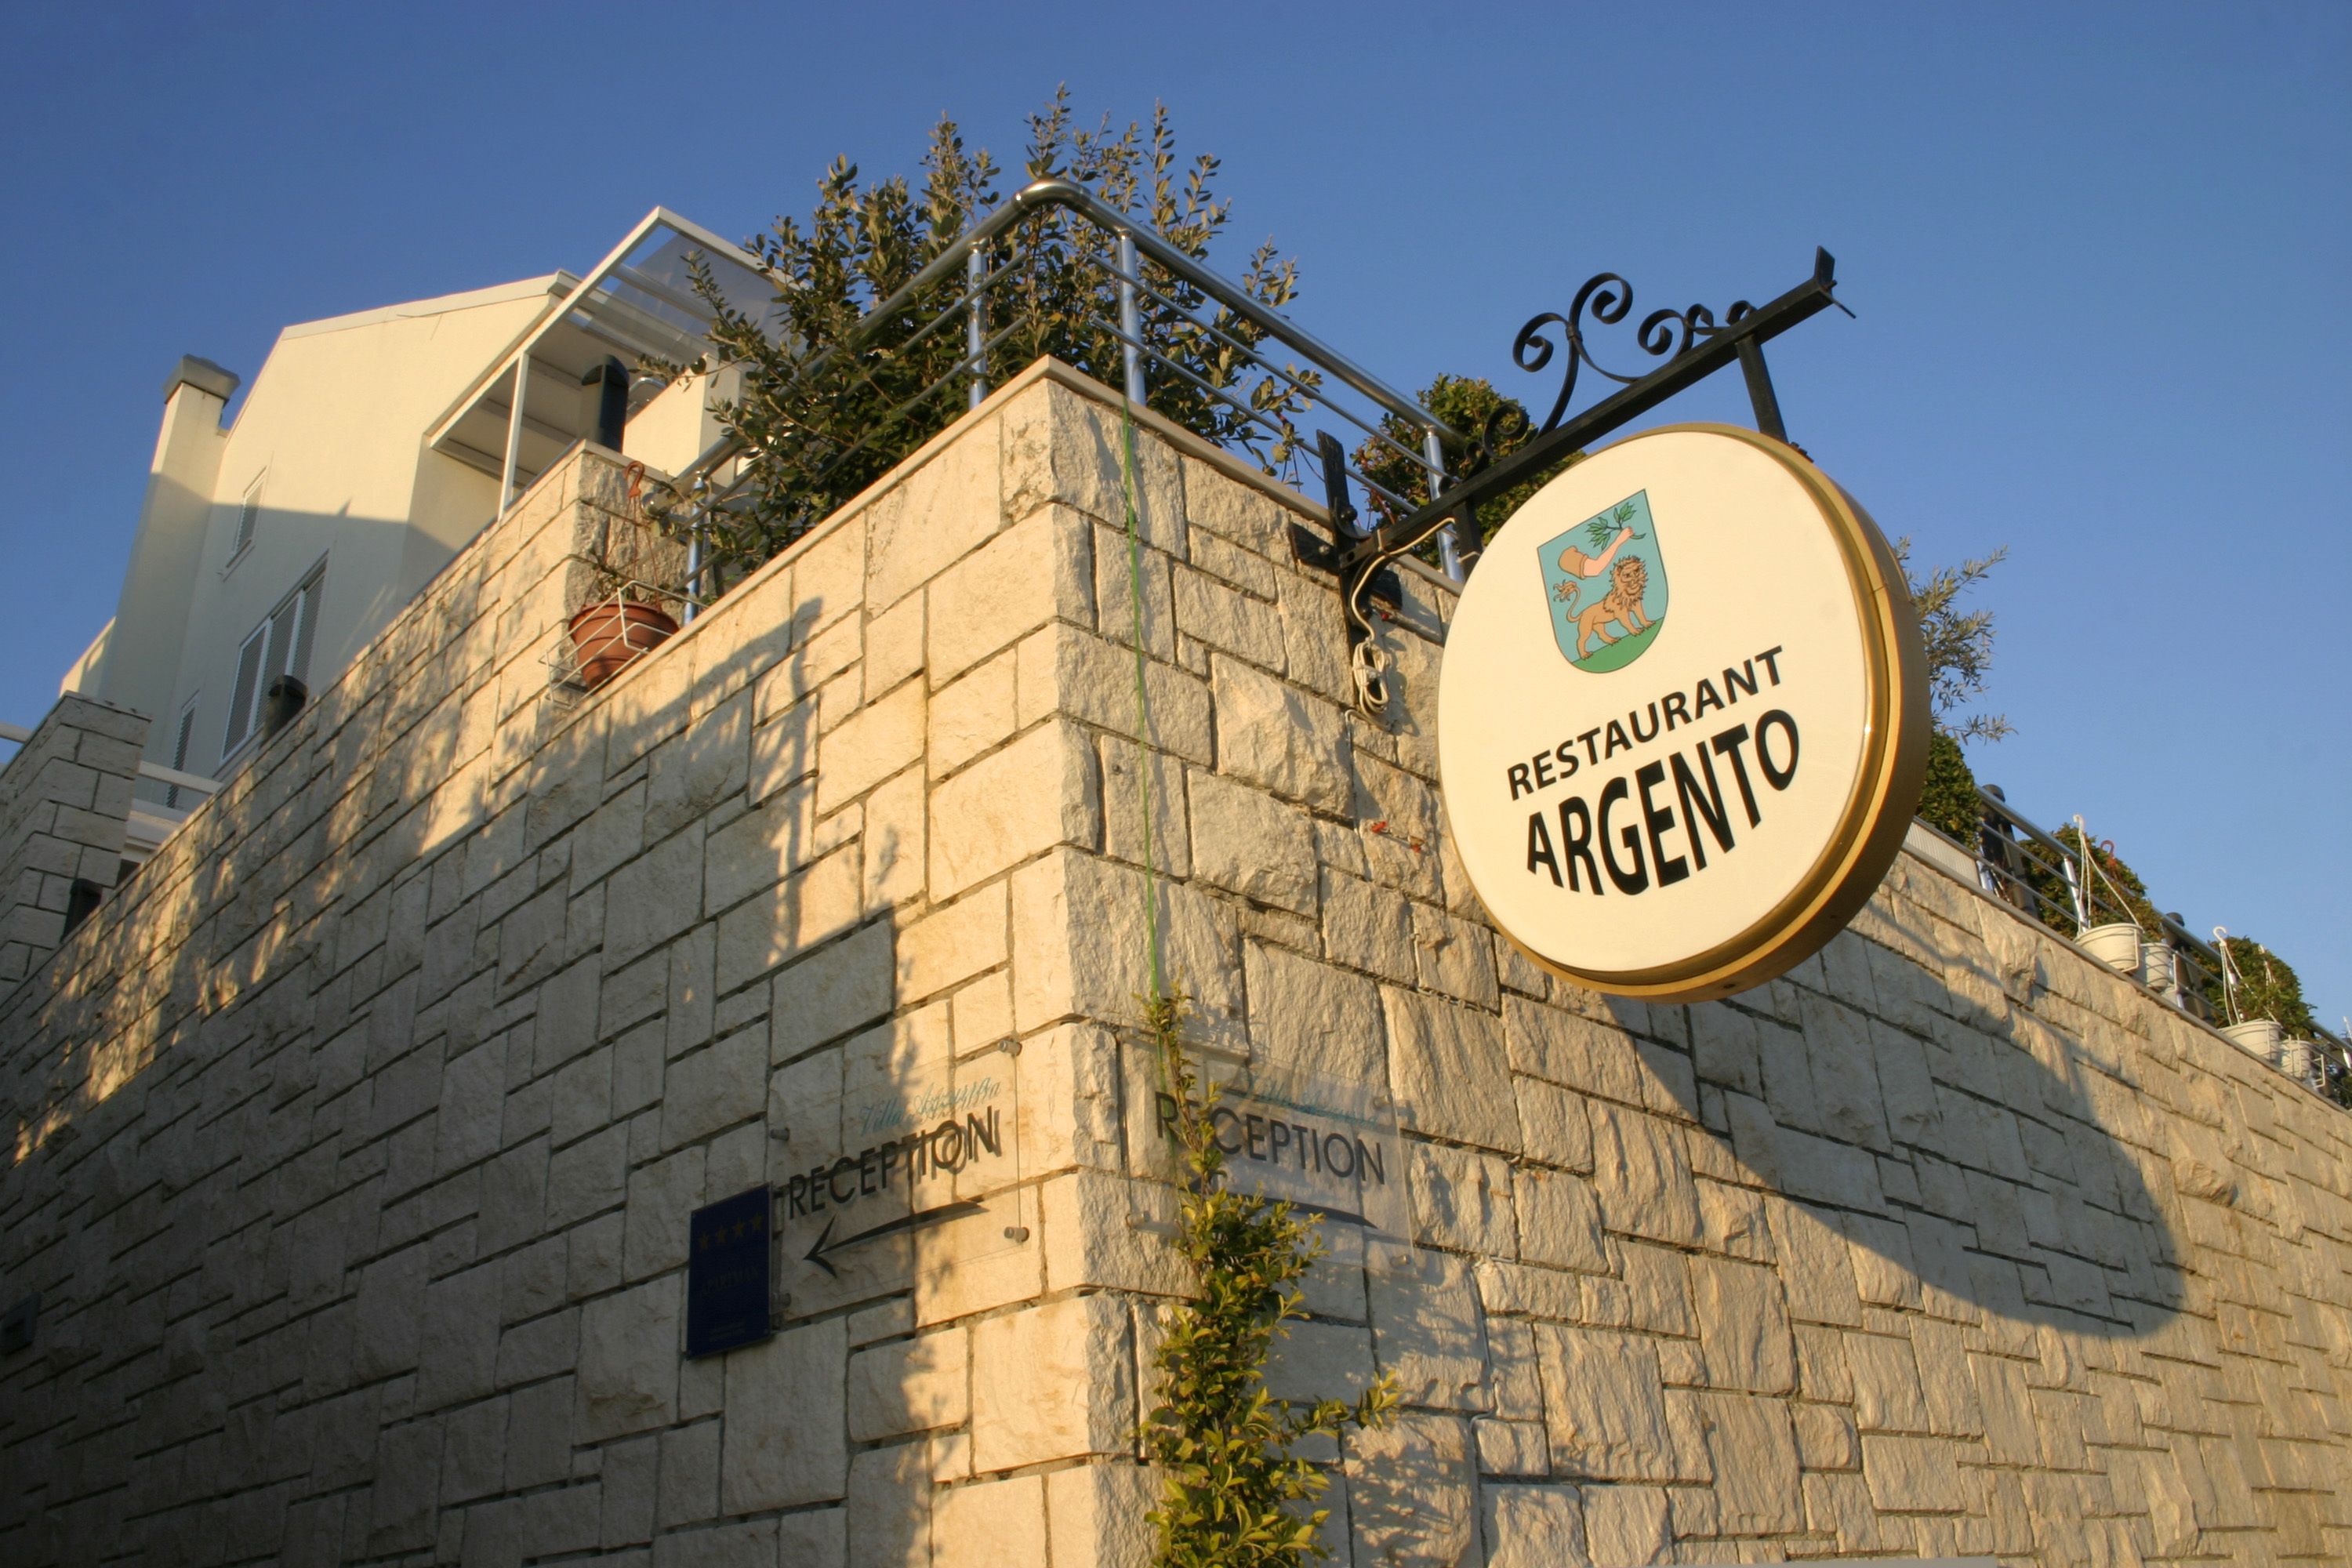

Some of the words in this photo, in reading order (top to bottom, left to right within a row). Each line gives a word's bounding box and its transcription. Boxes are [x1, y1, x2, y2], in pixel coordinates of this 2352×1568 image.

[1507, 645, 1783, 801] RESTAURANT
[1526, 708, 1800, 896] ARGENTO
[789, 1105, 994, 1220] RECEPTION
